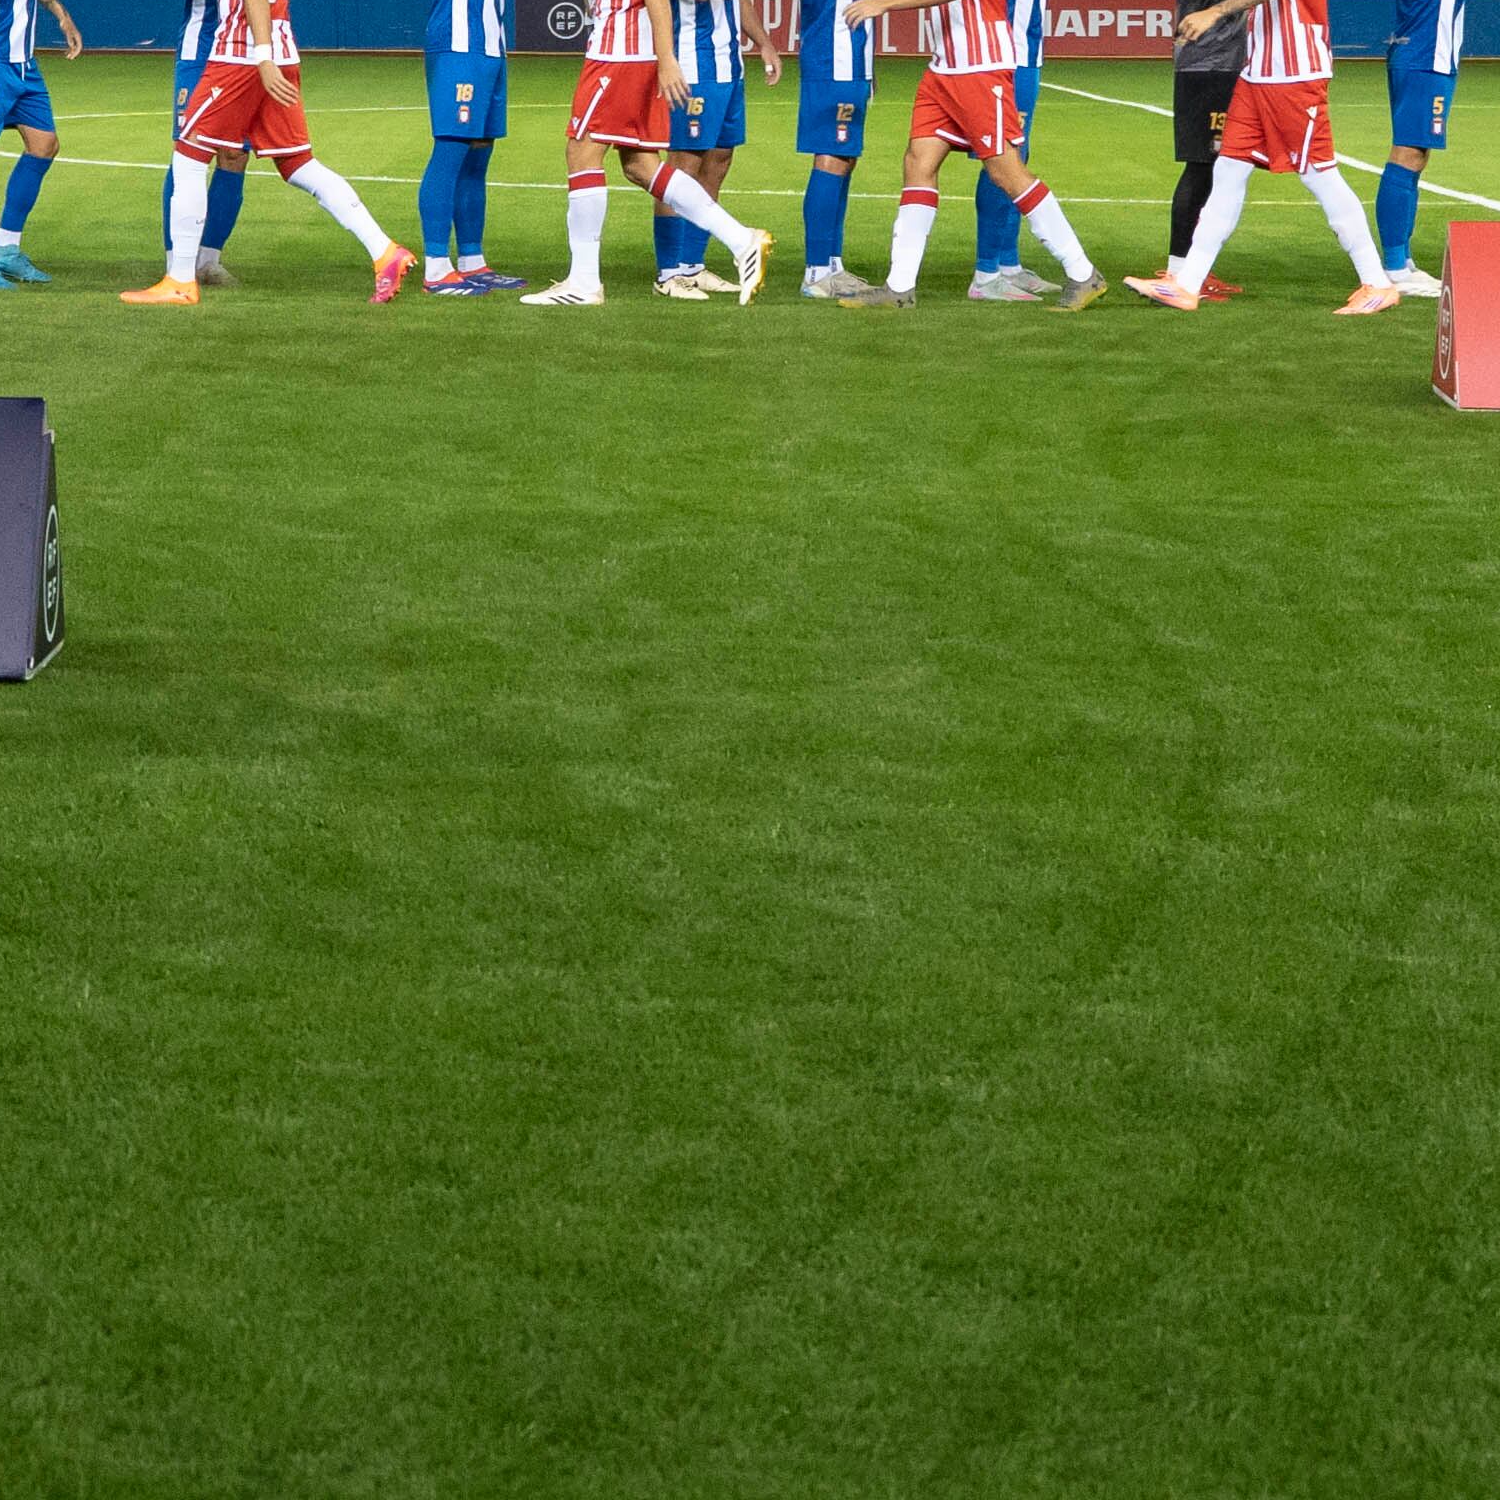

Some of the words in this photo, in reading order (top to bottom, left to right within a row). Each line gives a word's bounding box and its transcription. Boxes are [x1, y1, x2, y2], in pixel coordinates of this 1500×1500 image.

[555, 11, 577, 20] RF
[1043, 9, 1173, 38] APFR
[555, 21, 577, 31] EF
[836, 103, 854, 121] 12
[1432, 96, 1445, 115] 5
